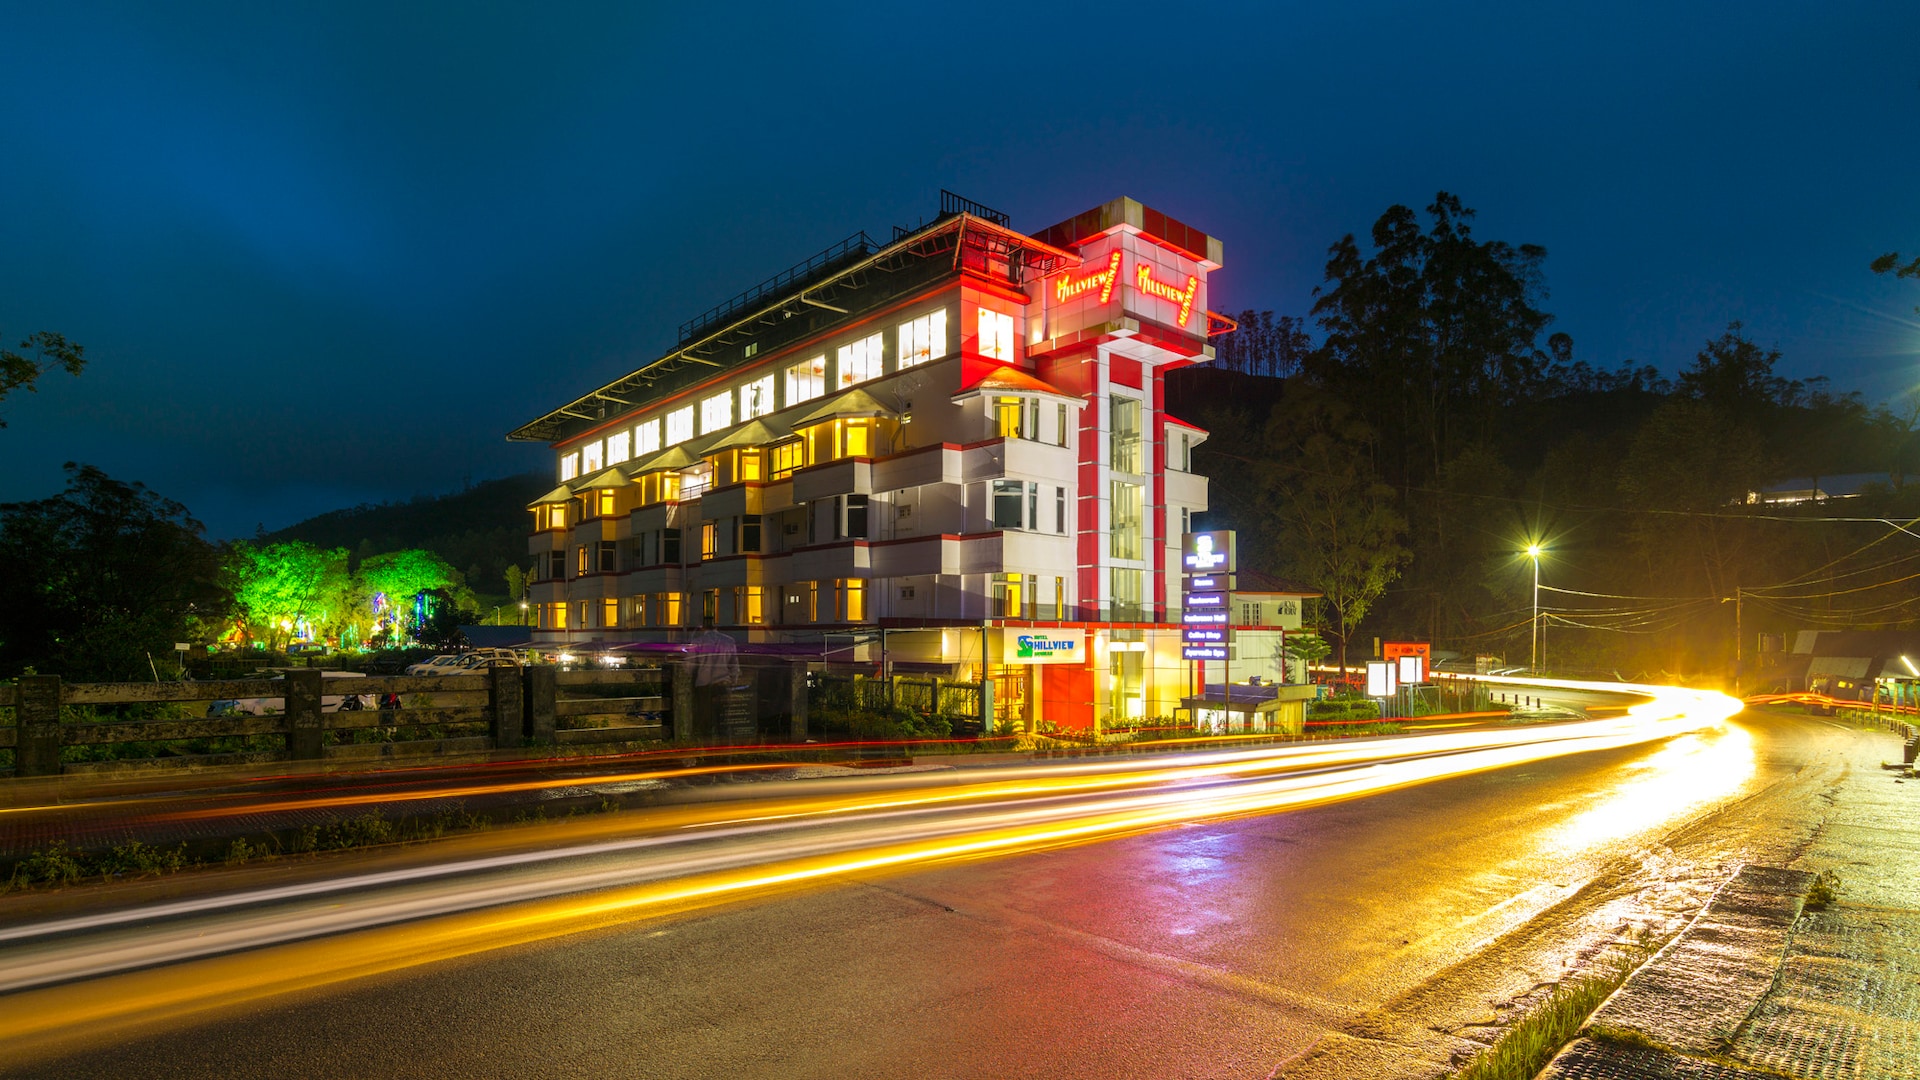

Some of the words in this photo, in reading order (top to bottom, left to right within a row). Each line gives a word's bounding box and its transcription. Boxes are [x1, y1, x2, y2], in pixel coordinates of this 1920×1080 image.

[1057, 272, 1108, 302] HILLVIEW
[1101, 252, 1121, 303] MUNNAR
[1137, 264, 1185, 302] HILLVIEW
[1178, 275, 1197, 327] MUNNAR
[1034, 641, 1074, 650] HILLVIEW
[1213, 649, 1225, 657] Spa
